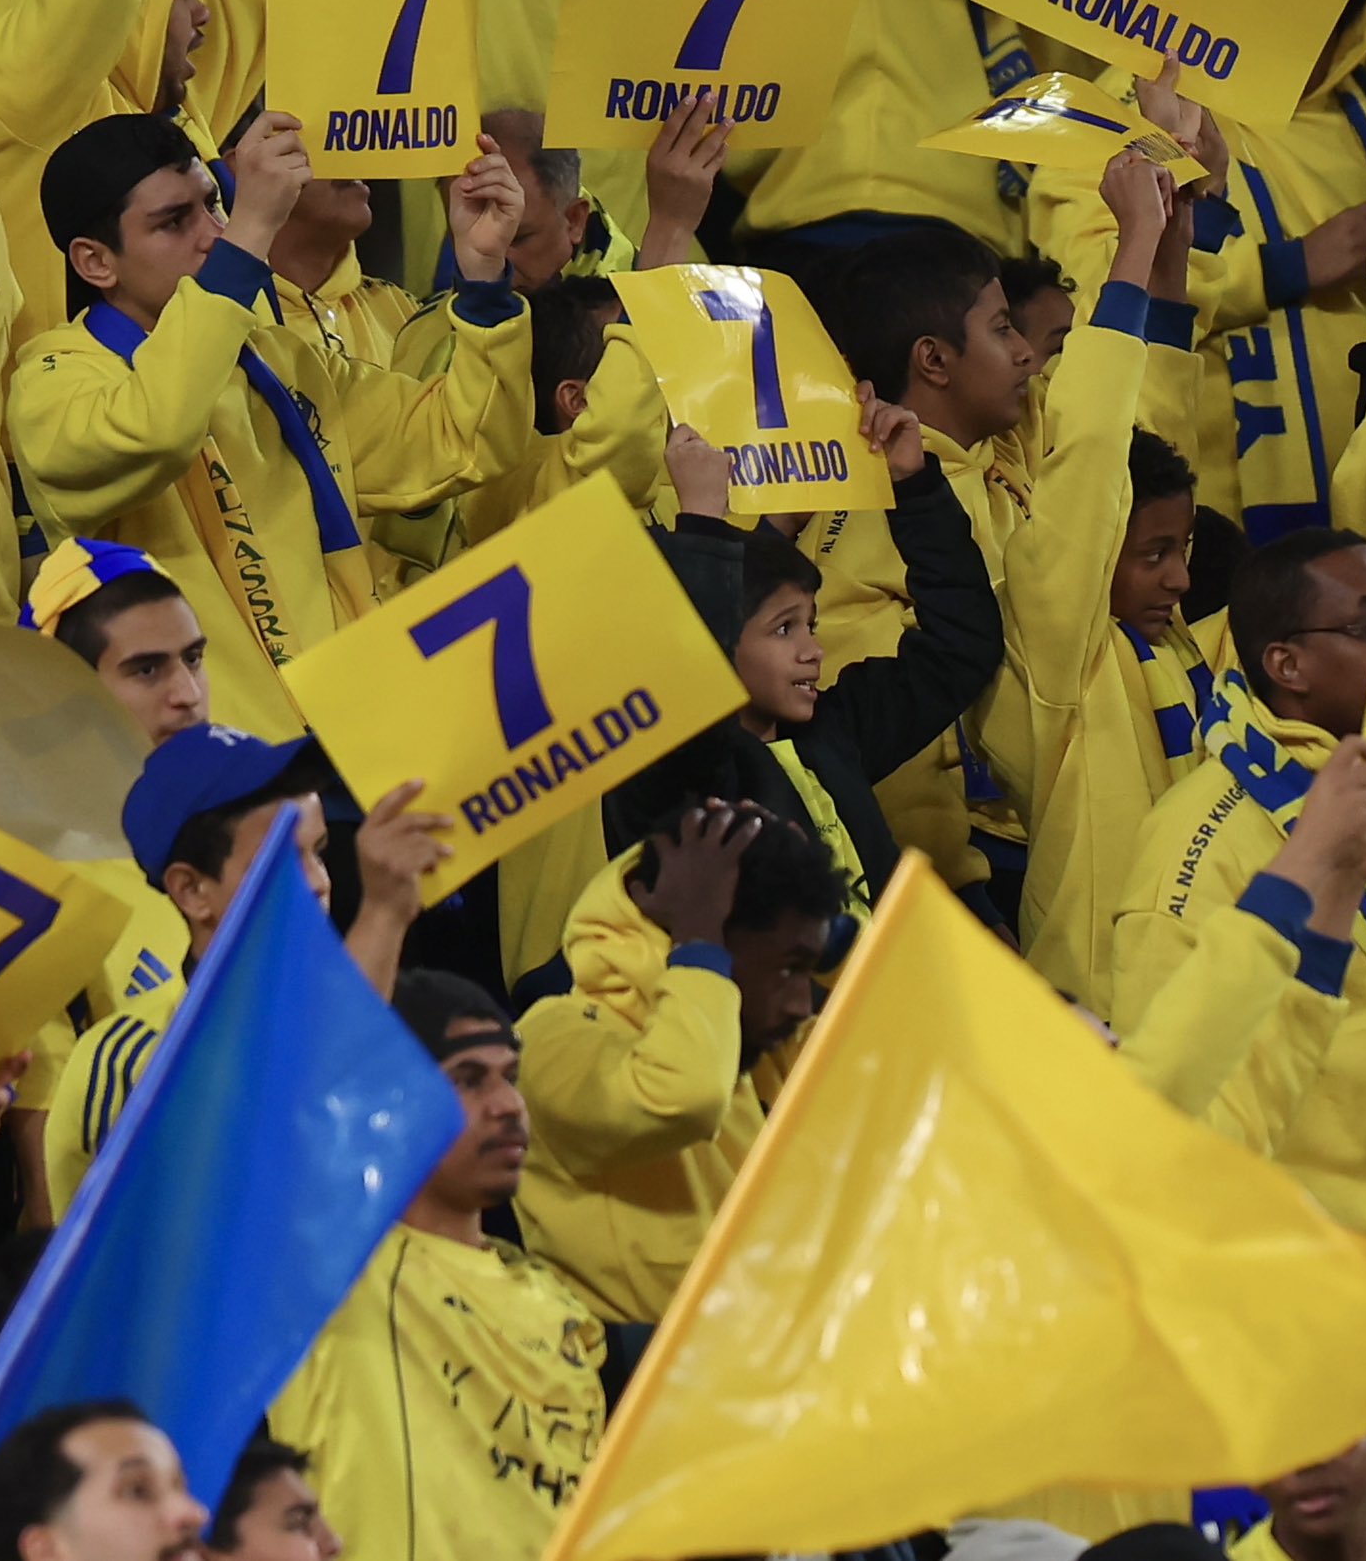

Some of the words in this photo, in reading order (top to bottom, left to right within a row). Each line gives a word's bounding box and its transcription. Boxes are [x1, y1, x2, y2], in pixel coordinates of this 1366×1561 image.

[327, 107, 457, 151] RONALDO
[701, 289, 788, 429] 7
[725, 441, 849, 487] RONALDO
[827, 509, 848, 536] NAS
[820, 537, 837, 554] AL
[411, 567, 553, 750] 7
[460, 687, 661, 835] RONALDO
[1208, 782, 1248, 825] KNIG
[1176, 823, 1218, 888] NASSR
[1168, 893, 1189, 918] AL
